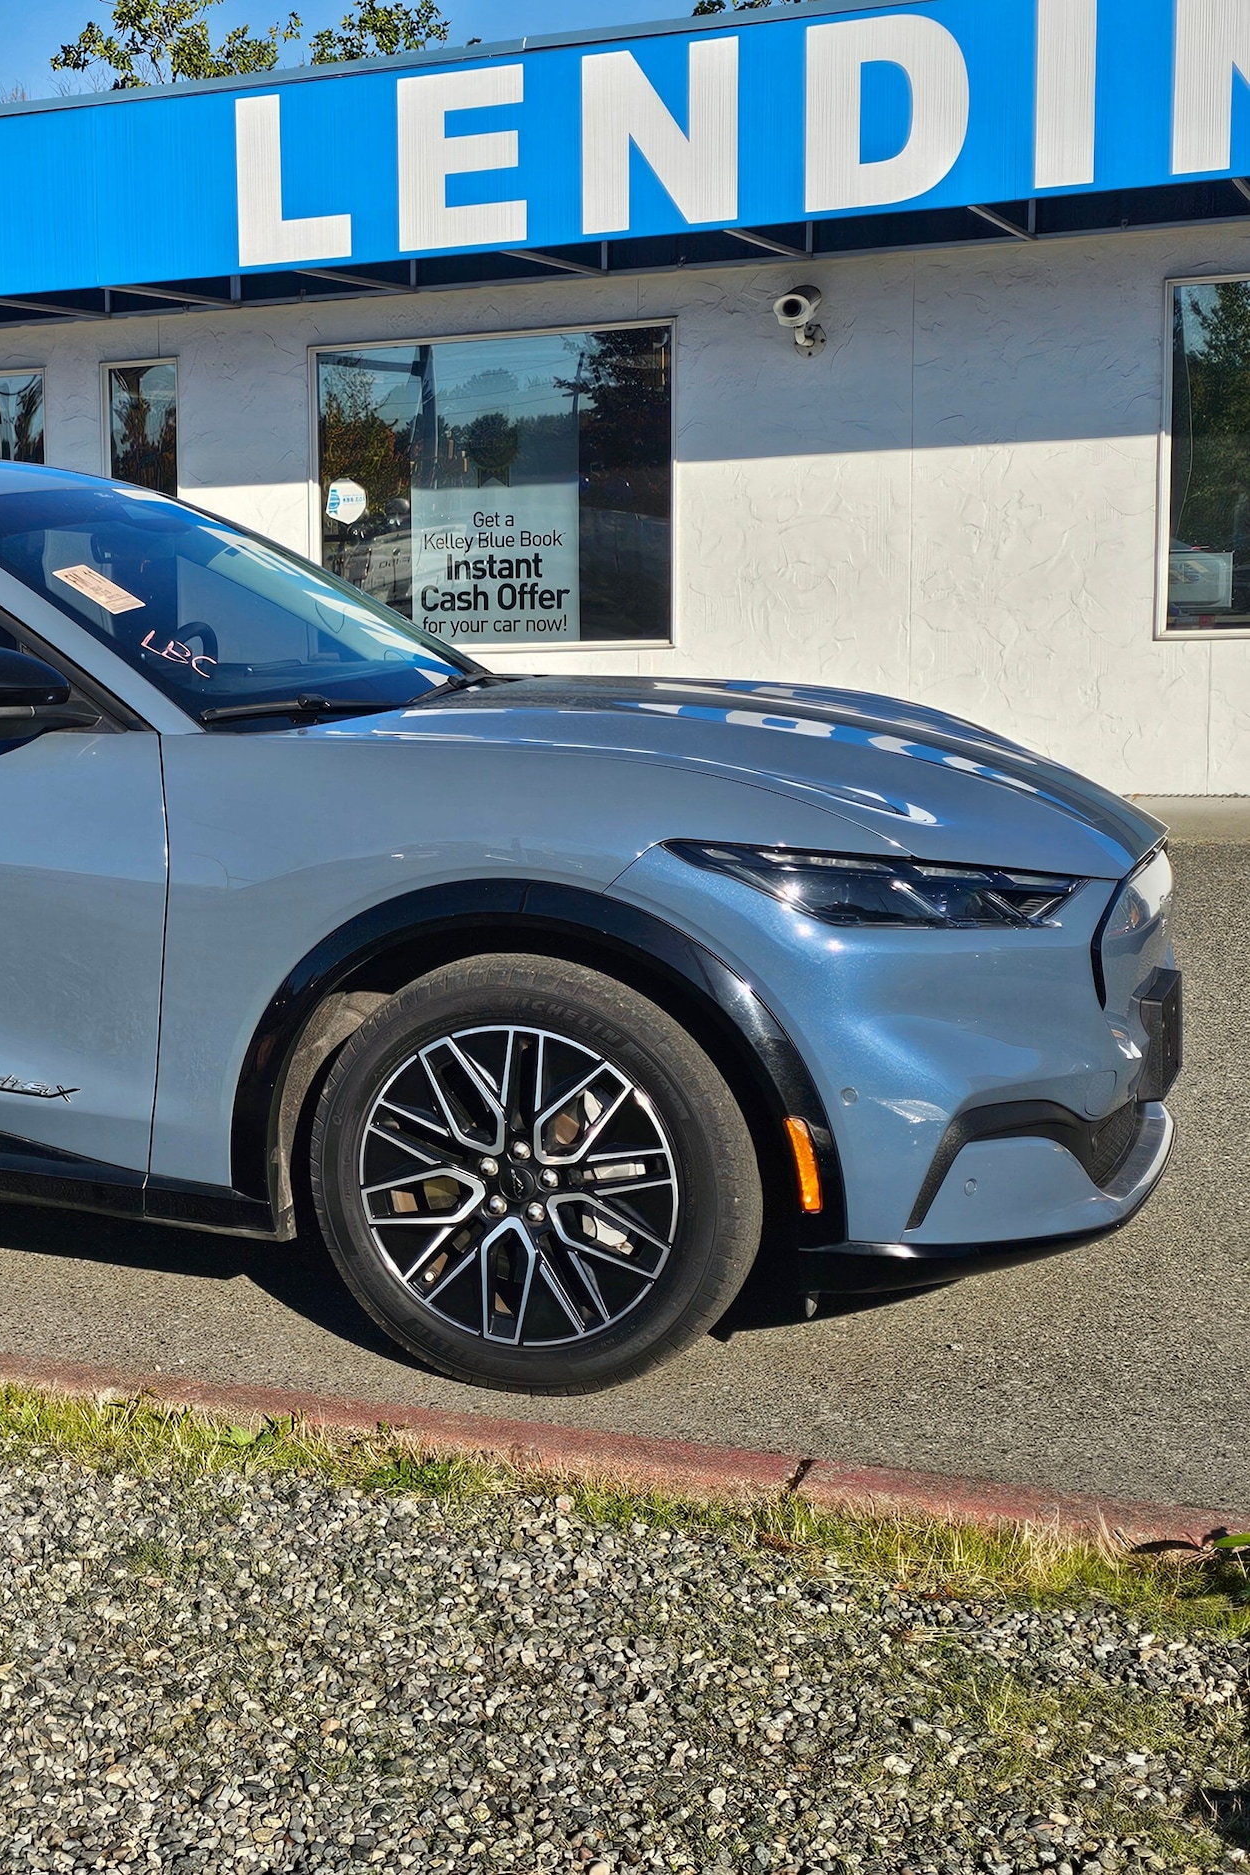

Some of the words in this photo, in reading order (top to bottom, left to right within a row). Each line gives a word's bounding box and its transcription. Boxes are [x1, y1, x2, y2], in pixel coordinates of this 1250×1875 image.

[473, 511, 500, 528] Get
[505, 515, 514, 527] a
[424, 532, 474, 554] Kelley
[478, 531, 515, 548] Blue
[520, 530, 562, 547] Book
[446, 553, 543, 580] Instant
[421, 584, 489, 612] Cash
[497, 583, 570, 611] Offer
[423, 617, 446, 634] for
[450, 620, 488, 638] your
[493, 620, 521, 633] car
[526, 614, 567, 632] now!
